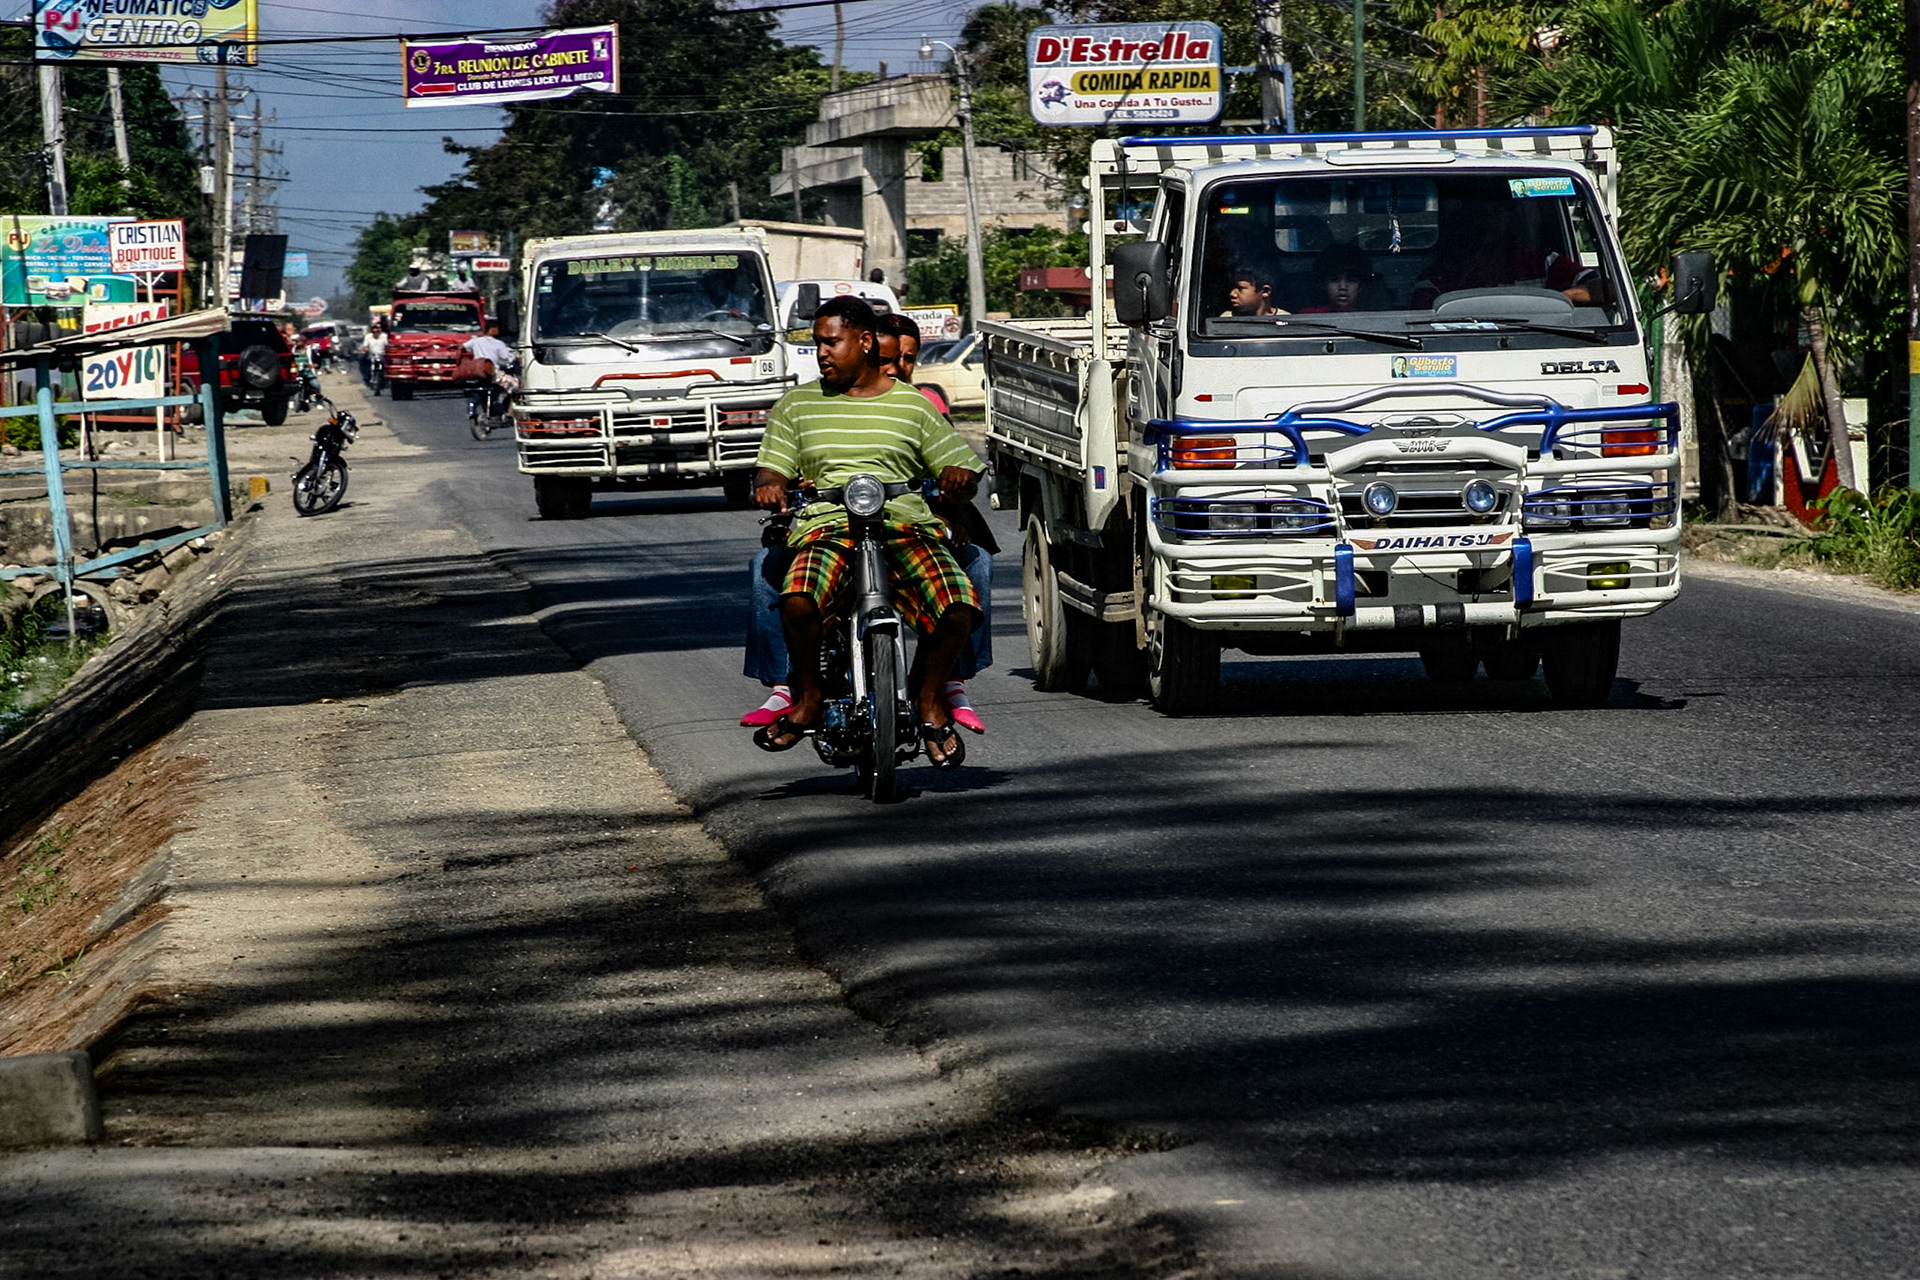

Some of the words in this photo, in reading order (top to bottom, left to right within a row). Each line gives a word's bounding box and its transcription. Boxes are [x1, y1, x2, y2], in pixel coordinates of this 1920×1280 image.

[44, 10, 79, 31] PJ
[84, 19, 202, 44] CENTRO
[1036, 32, 1212, 64] D'Estrella
[513, 56, 530, 70] DE
[532, 50, 590, 67] GABINETE
[457, 82, 481, 91] CLUB
[483, 81, 496, 90] DE
[497, 78, 532, 89] LEONES
[534, 75, 560, 85] LICEY
[561, 74, 573, 83] AL
[574, 71, 605, 81] MEDIO
[1079, 72, 1143, 92] COMIDA
[1150, 71, 1211, 89] RAPIDA
[1074, 100, 1096, 109] Una
[1100, 98, 1139, 108] Comida
[1143, 98, 1151, 106] A
[1154, 97, 1167, 106] Tu
[9, 233, 29, 245] PJ
[118, 224, 181, 244] CRISTIAN
[117, 246, 176, 263] BOUTIQUE
[655, 255, 739, 270] MUEBLES
[1540, 360, 1620, 375] DELTA
[1374, 534, 1494, 550] DAIHATSU
